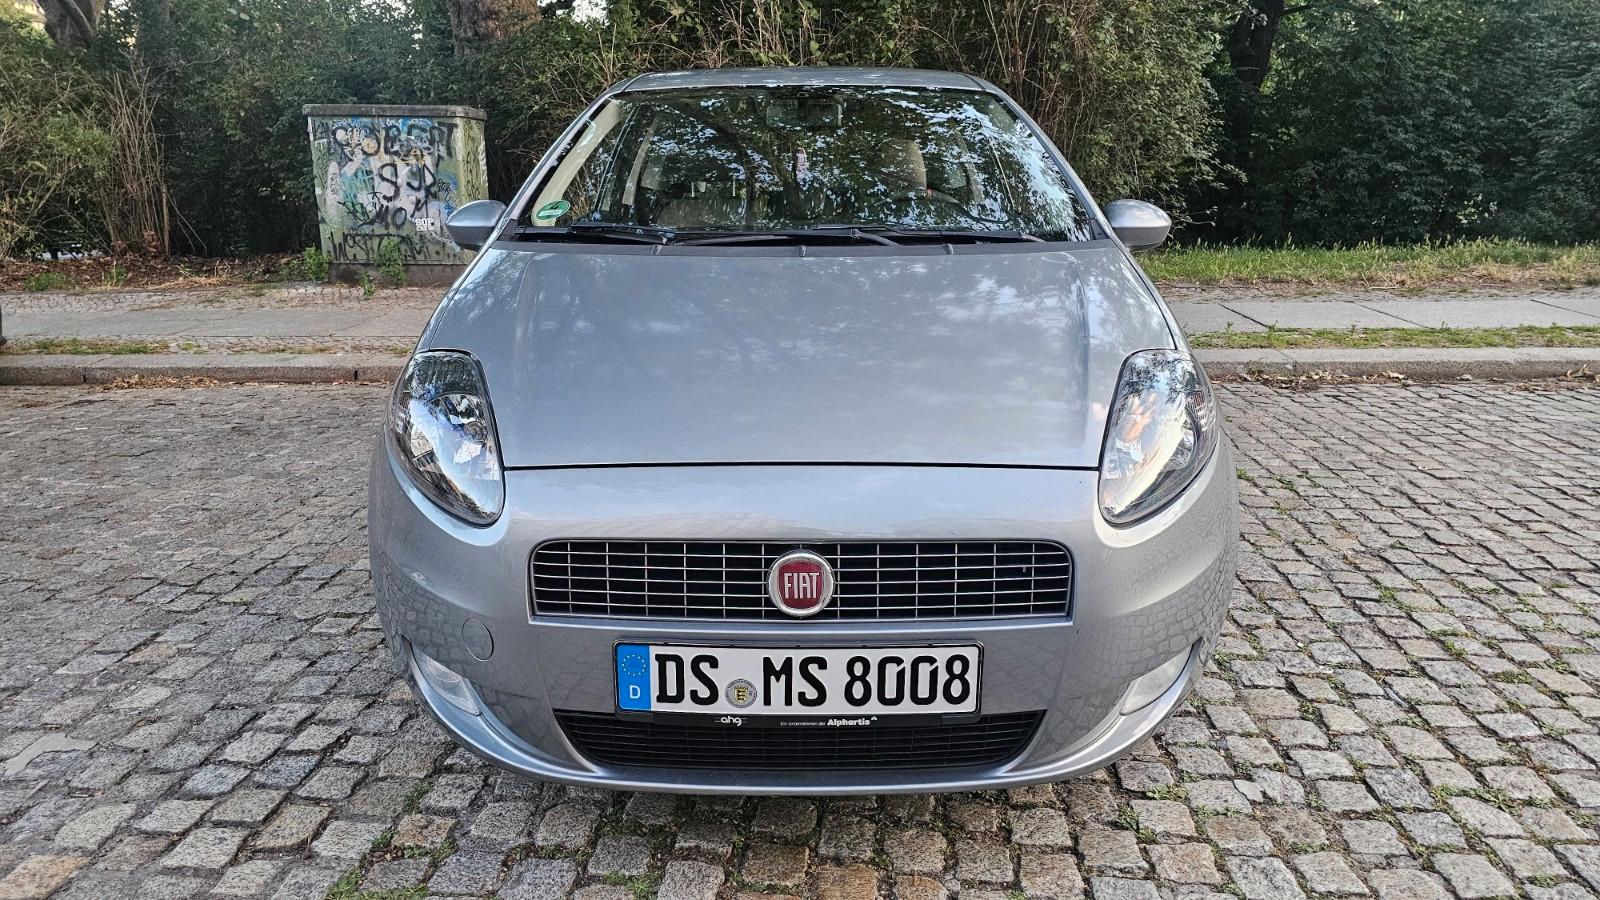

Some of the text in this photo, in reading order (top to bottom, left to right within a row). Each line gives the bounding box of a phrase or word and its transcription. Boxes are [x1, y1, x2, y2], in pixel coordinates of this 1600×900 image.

[784, 572, 820, 599] FIAT
[655, 653, 719, 706] DS
[762, 656, 828, 707] MS
[844, 655, 971, 707] 8008
[629, 685, 641, 699] D
[720, 716, 742, 727] ahg
[827, 718, 871, 727] Alphartis
